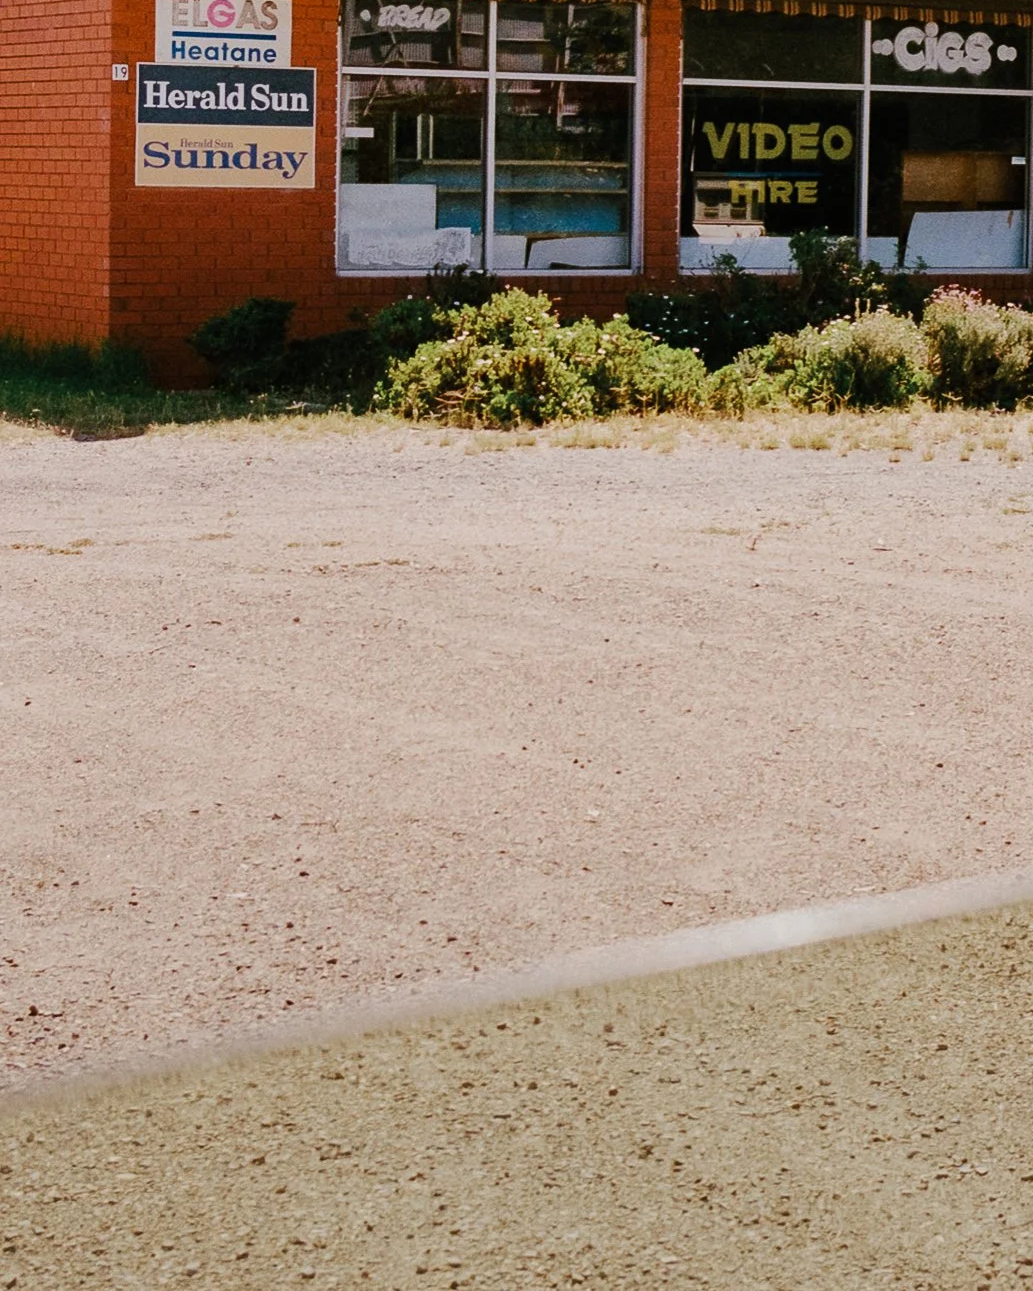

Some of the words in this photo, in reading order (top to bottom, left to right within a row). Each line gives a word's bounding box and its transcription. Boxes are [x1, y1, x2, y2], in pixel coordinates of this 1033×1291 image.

[171, 40, 278, 63] Heatane
[114, 66, 128, 78] 19
[143, 80, 247, 111] Herald
[250, 83, 310, 112] Sun
[180, 138, 212, 148] Herald
[214, 140, 234, 149] Sun
[702, 121, 853, 160] VIDEO
[143, 141, 309, 179] Sunday
[728, 180, 818, 204] HIRE
